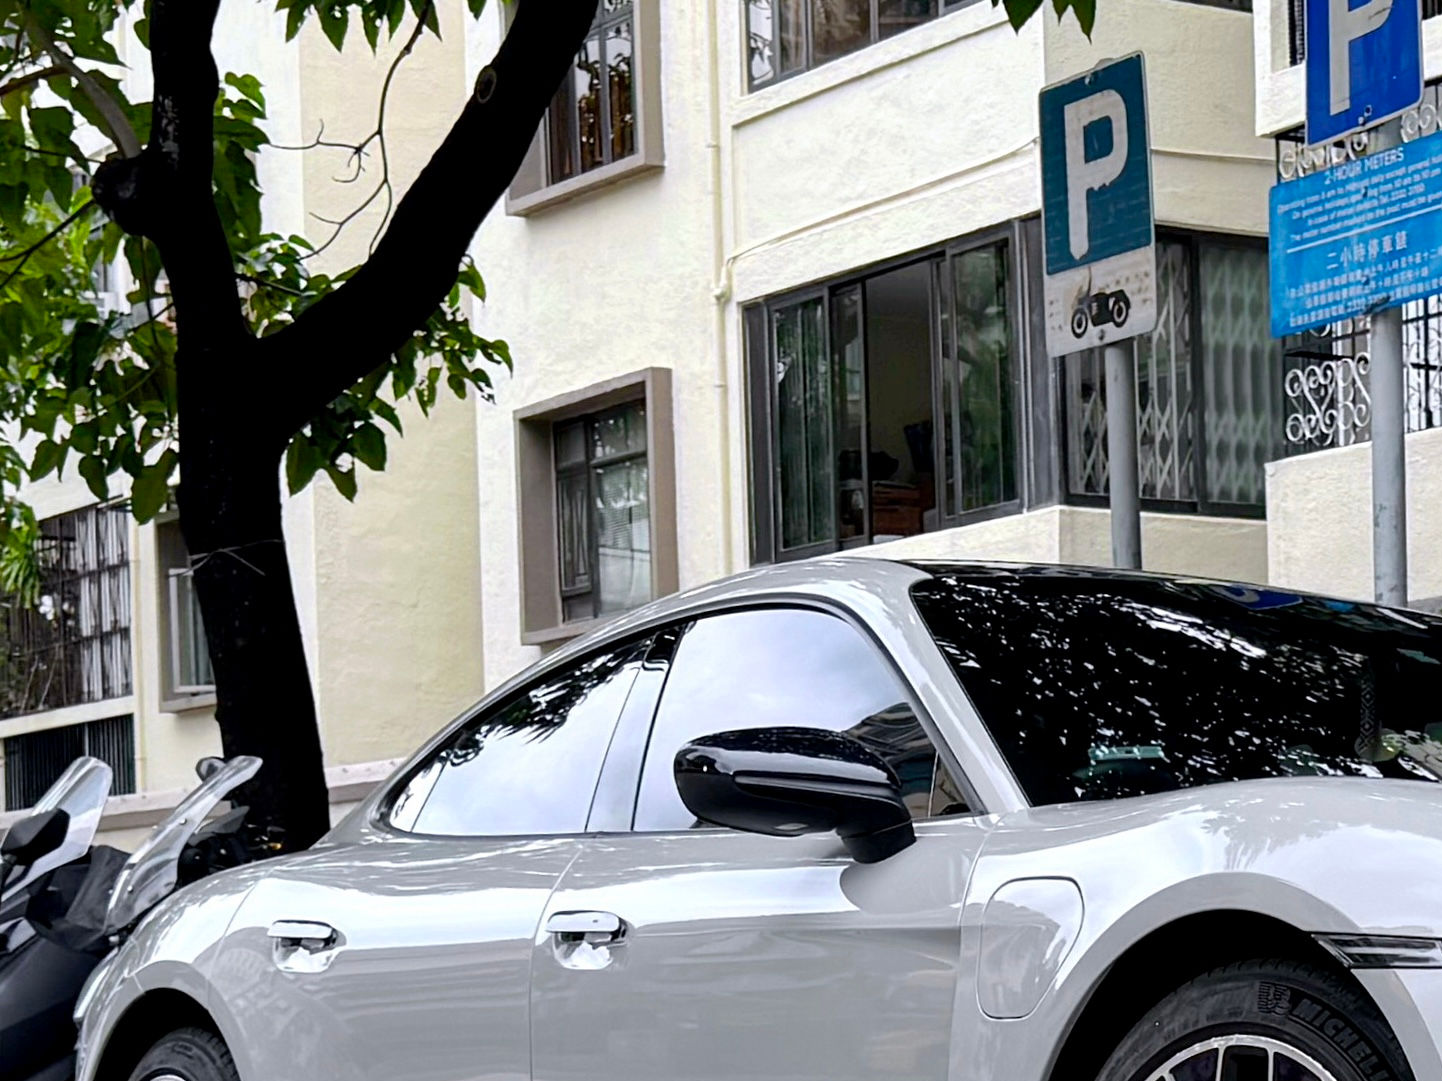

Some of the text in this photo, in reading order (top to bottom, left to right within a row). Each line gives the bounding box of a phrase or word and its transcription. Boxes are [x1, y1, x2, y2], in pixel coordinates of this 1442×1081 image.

[1329, 0, 1393, 115] P
[1063, 89, 1128, 260] P
[1324, 147, 1405, 185] 2-HOUR METERS
